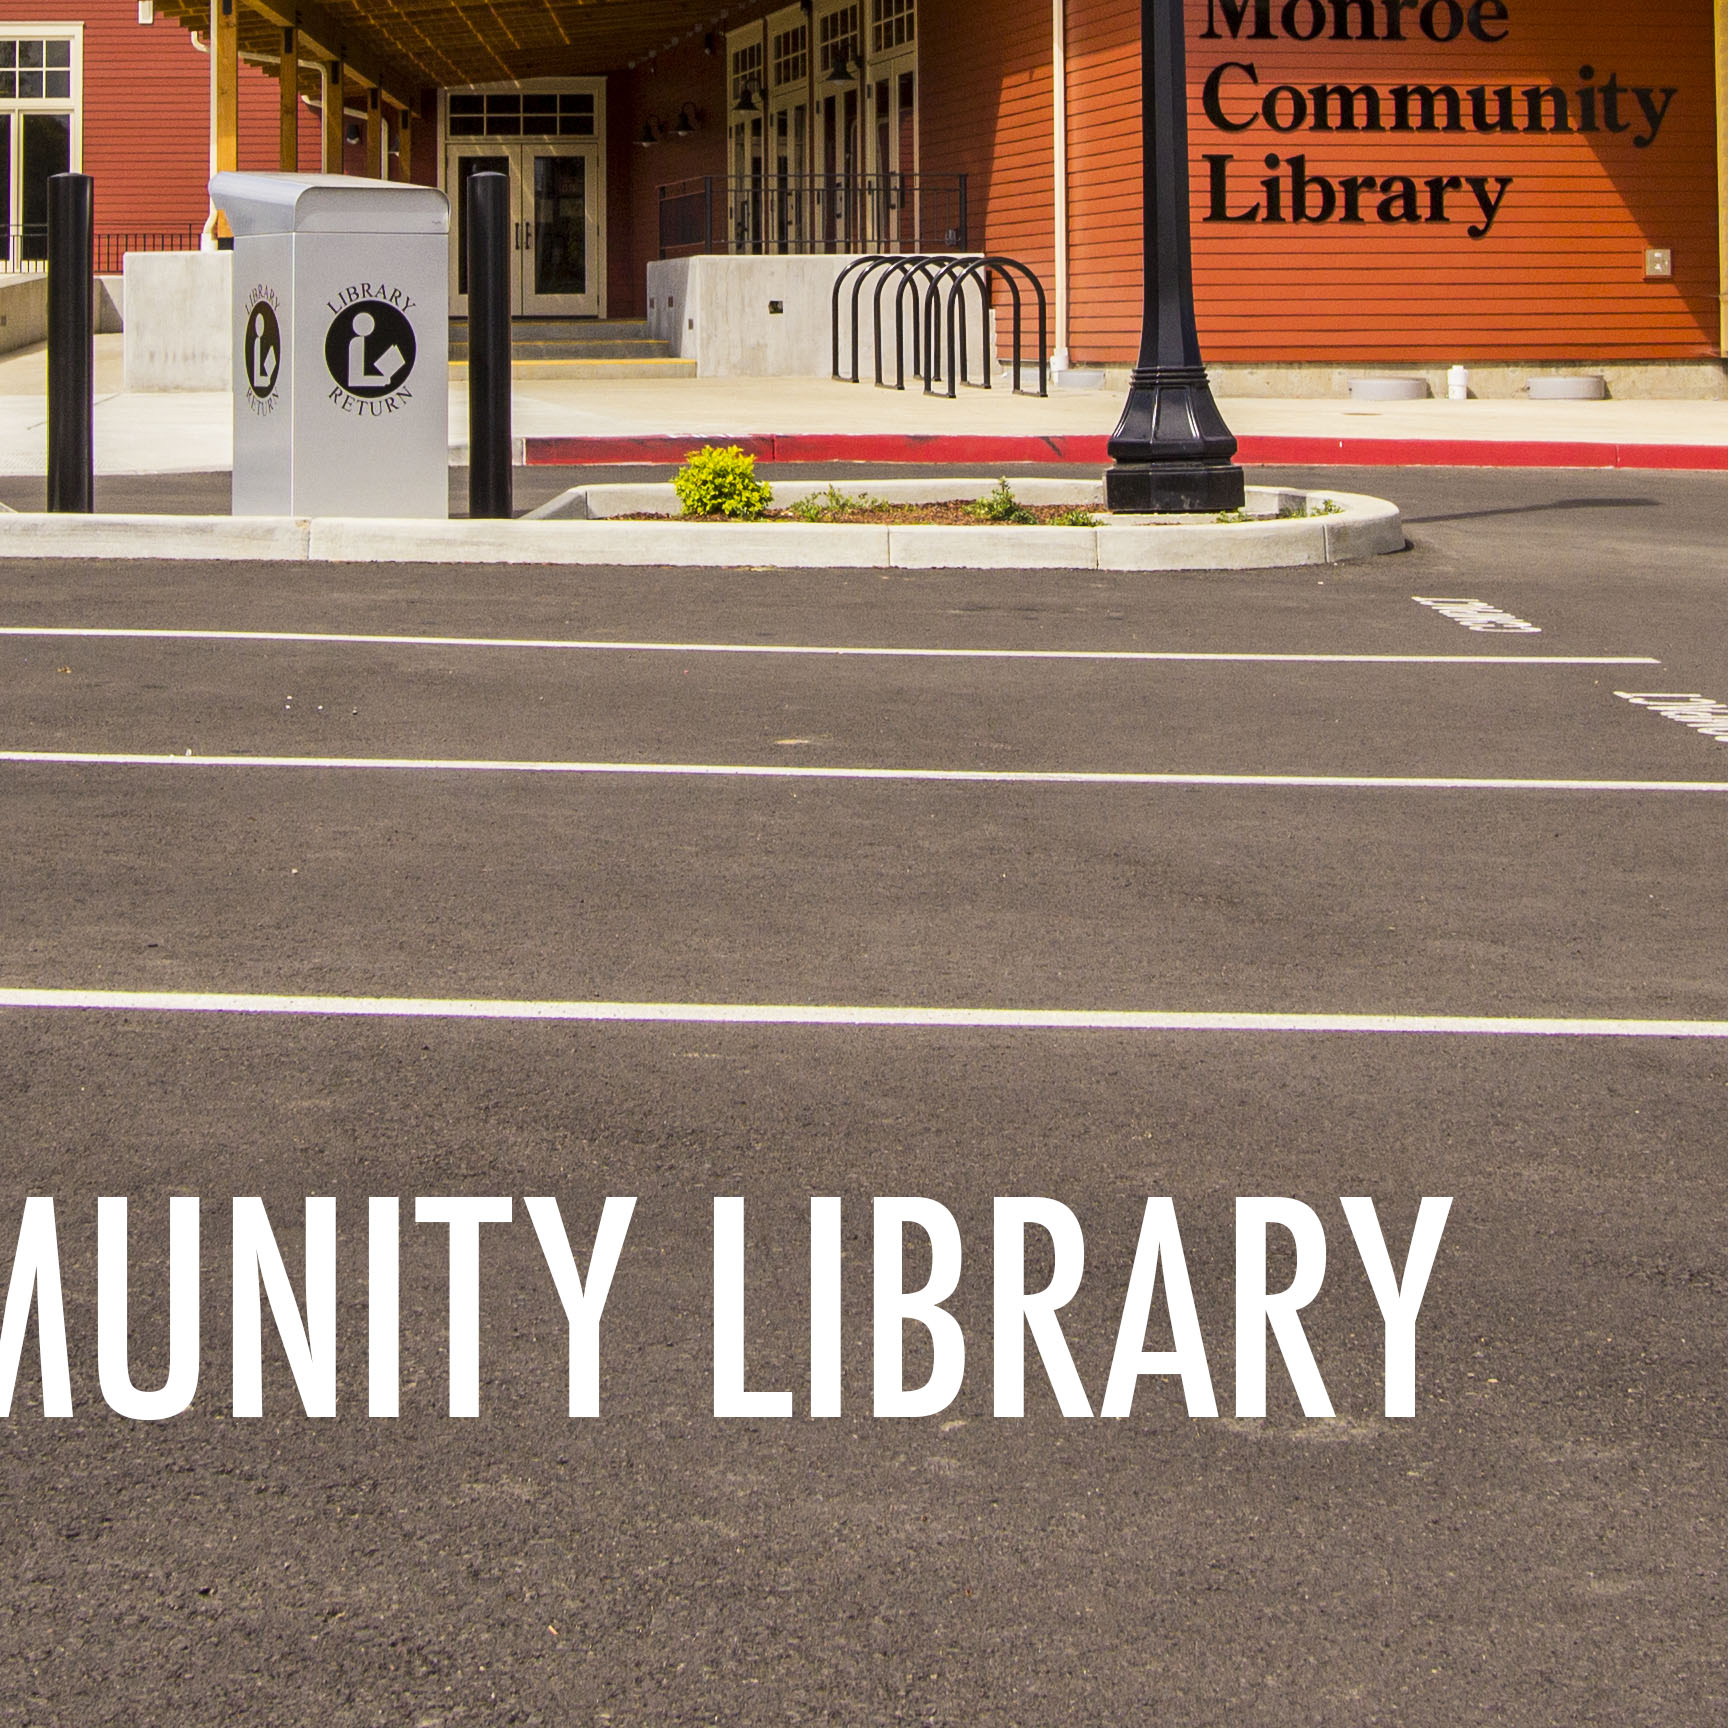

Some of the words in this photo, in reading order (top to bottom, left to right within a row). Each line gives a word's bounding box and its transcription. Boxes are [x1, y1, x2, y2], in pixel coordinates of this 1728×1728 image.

[1201, 61, 1678, 148] Community
[1201, 152, 1513, 240] Library
[245, 283, 280, 315] LIBRARY
[326, 282, 417, 315] LIBRARY
[246, 385, 280, 417] RETURN
[328, 385, 413, 417] RETURN
